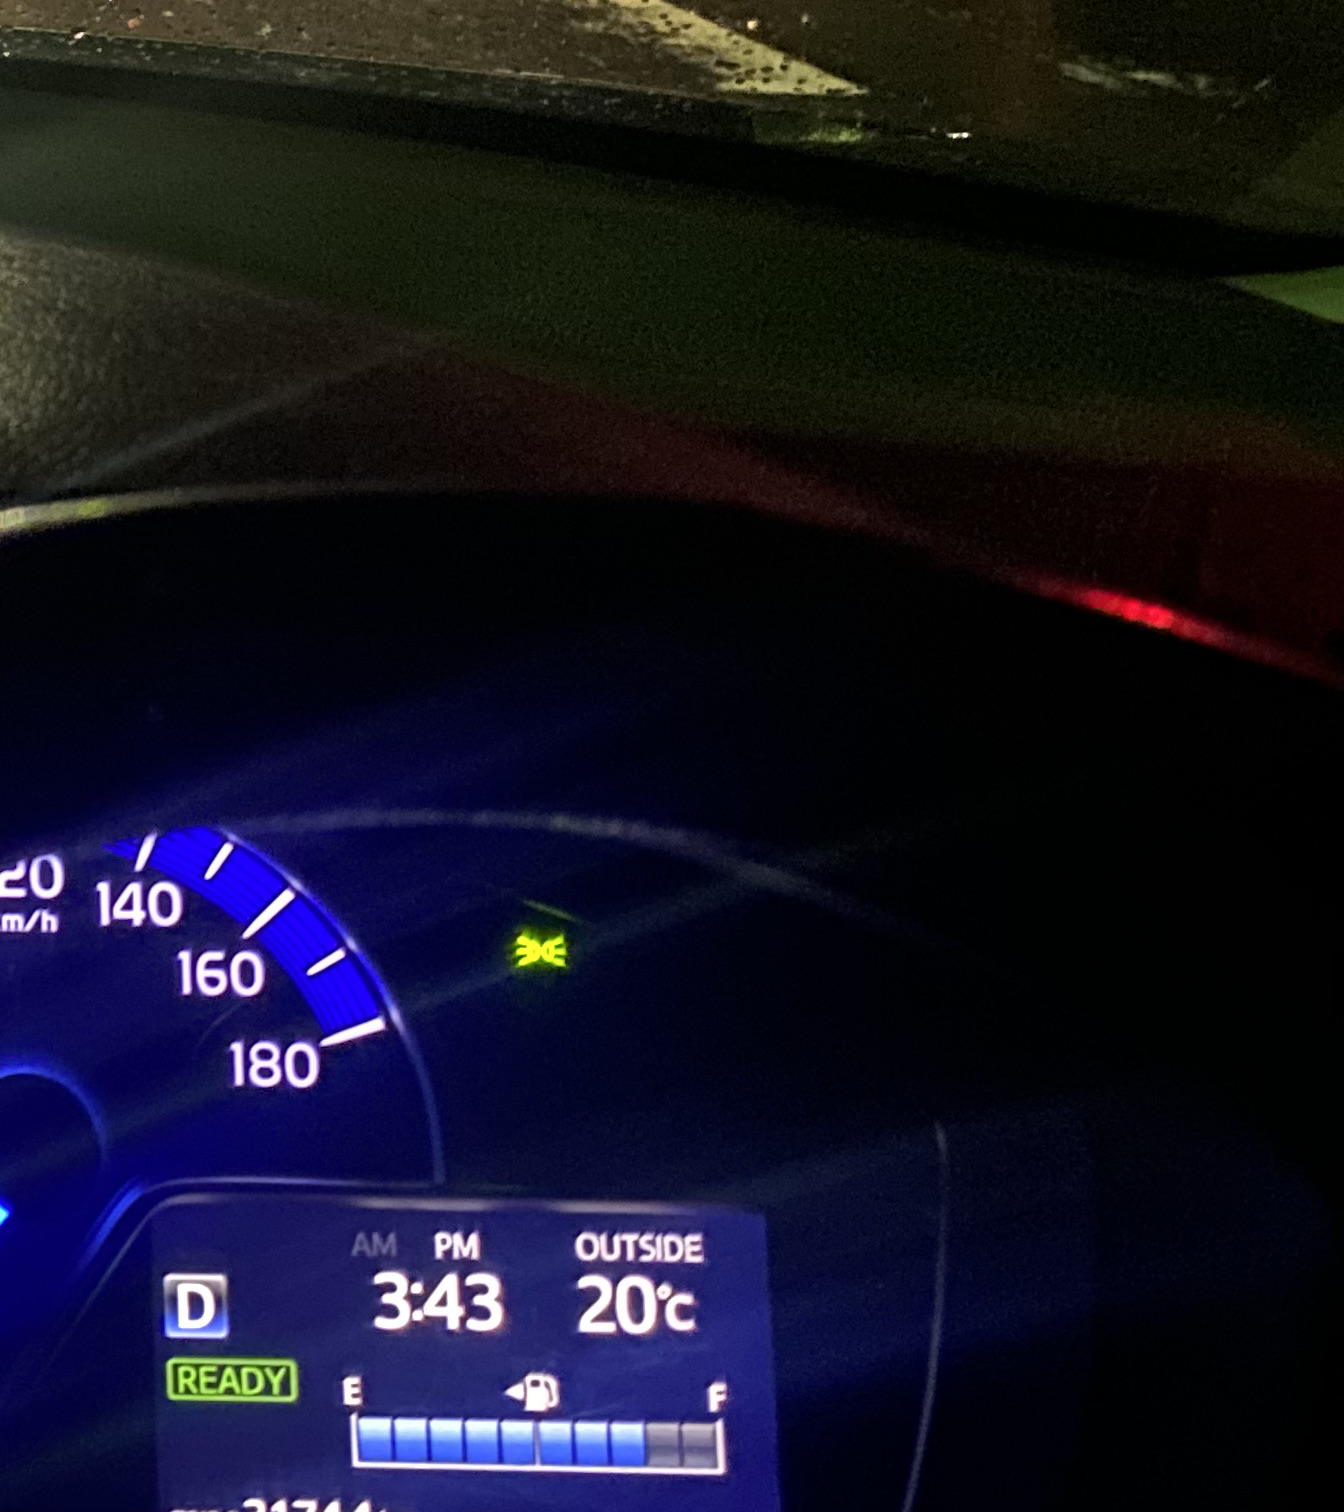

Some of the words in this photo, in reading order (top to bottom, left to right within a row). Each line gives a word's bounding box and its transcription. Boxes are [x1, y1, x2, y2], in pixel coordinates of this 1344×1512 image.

[97, 882, 181, 926] 140
[178, 951, 263, 996] 160
[231, 1042, 318, 1087] 180
[352, 1232, 397, 1257] AM
[435, 1232, 479, 1259] PM
[575, 1232, 704, 1263] OUTSIDE
[176, 1284, 215, 1329] D
[374, 1271, 503, 1331] 3:43
[177, 1368, 286, 1395] READY
[343, 1377, 362, 1405] E
[708, 1382, 726, 1412] F
